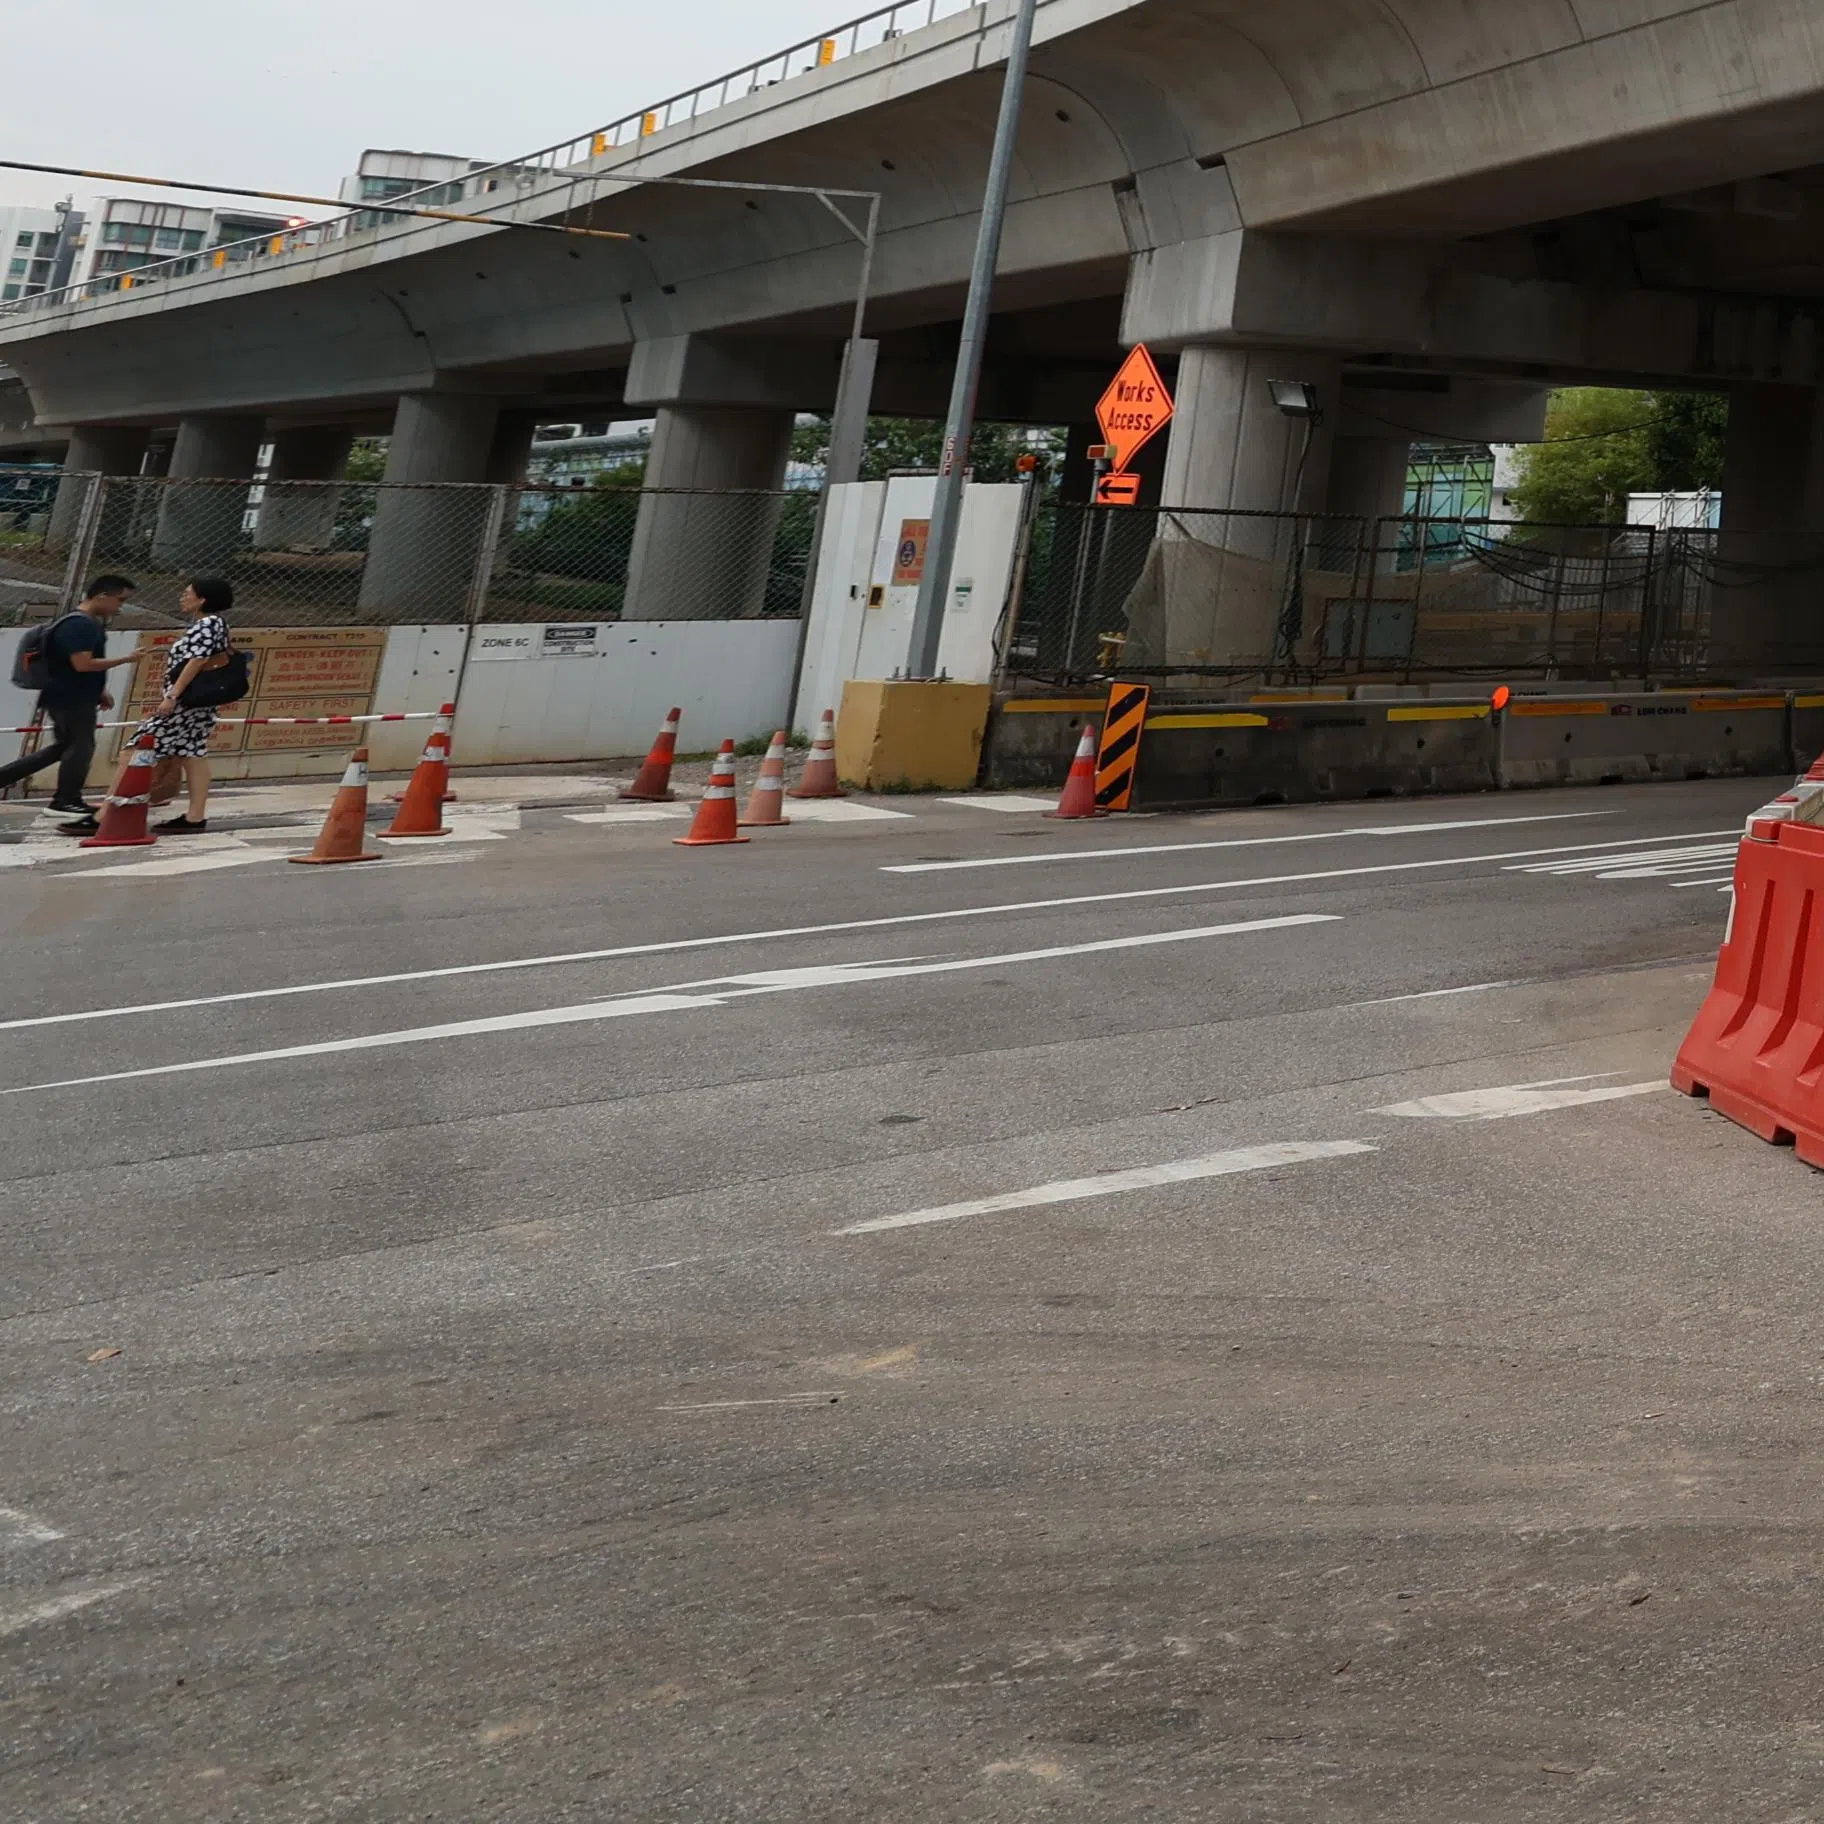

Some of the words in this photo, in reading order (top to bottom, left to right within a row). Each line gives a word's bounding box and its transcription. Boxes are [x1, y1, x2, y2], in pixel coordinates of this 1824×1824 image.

[1116, 380, 1155, 403] Works
[1106, 407, 1154, 431] Access
[481, 638, 513, 648] ZONE
[269, 700, 317, 711] SAFETY
[322, 699, 356, 709] FIRST
